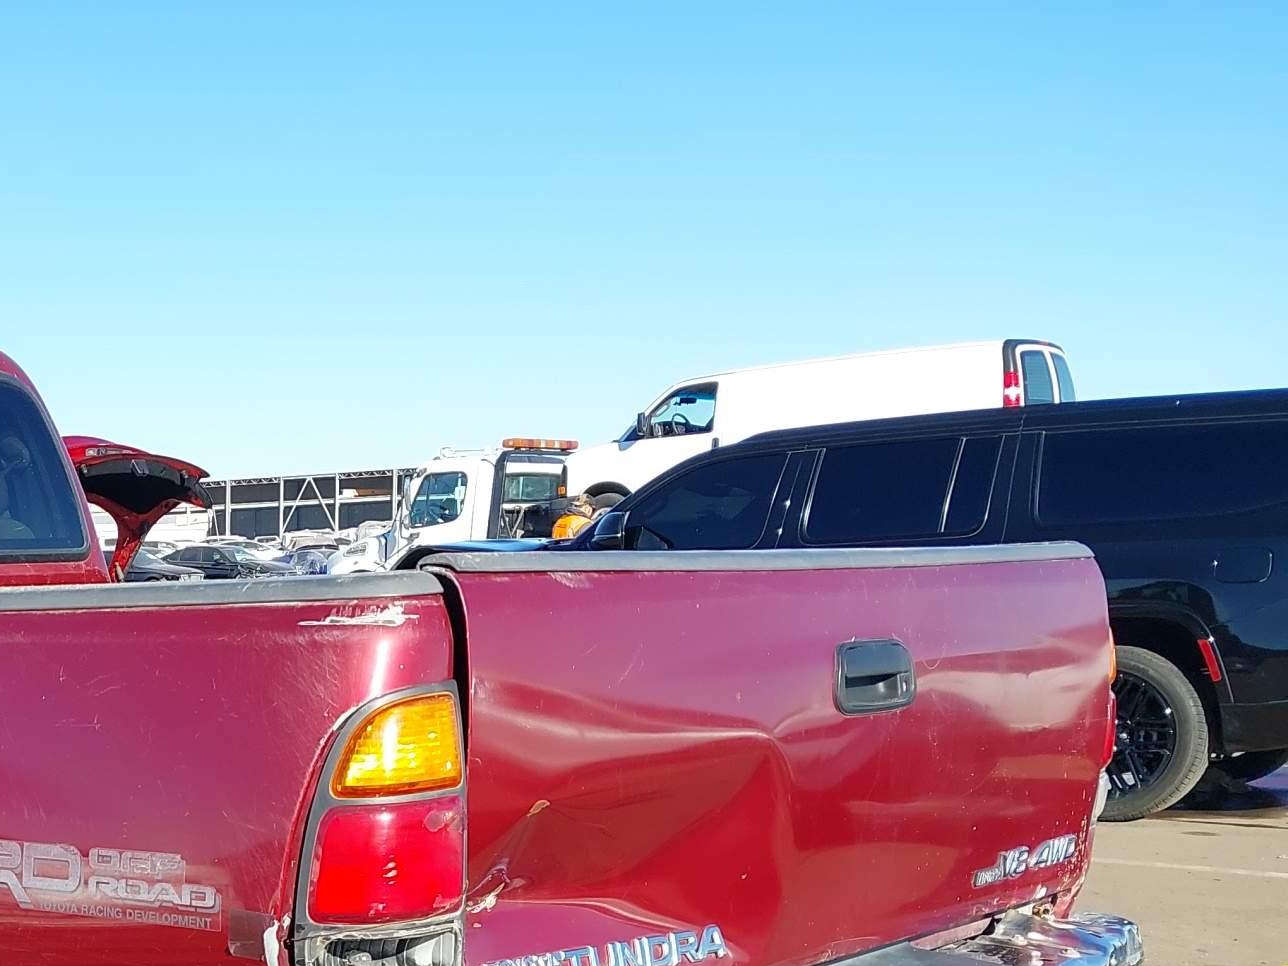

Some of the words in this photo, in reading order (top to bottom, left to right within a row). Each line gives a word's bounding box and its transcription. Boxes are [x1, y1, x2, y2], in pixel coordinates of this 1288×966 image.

[1032, 834, 1078, 866] 4WD
[87, 875, 221, 912] ROAD
[38, 902, 77, 914] TOYOTA
[81, 904, 122, 920] RACING
[126, 908, 213, 930] DEVELOPMENT
